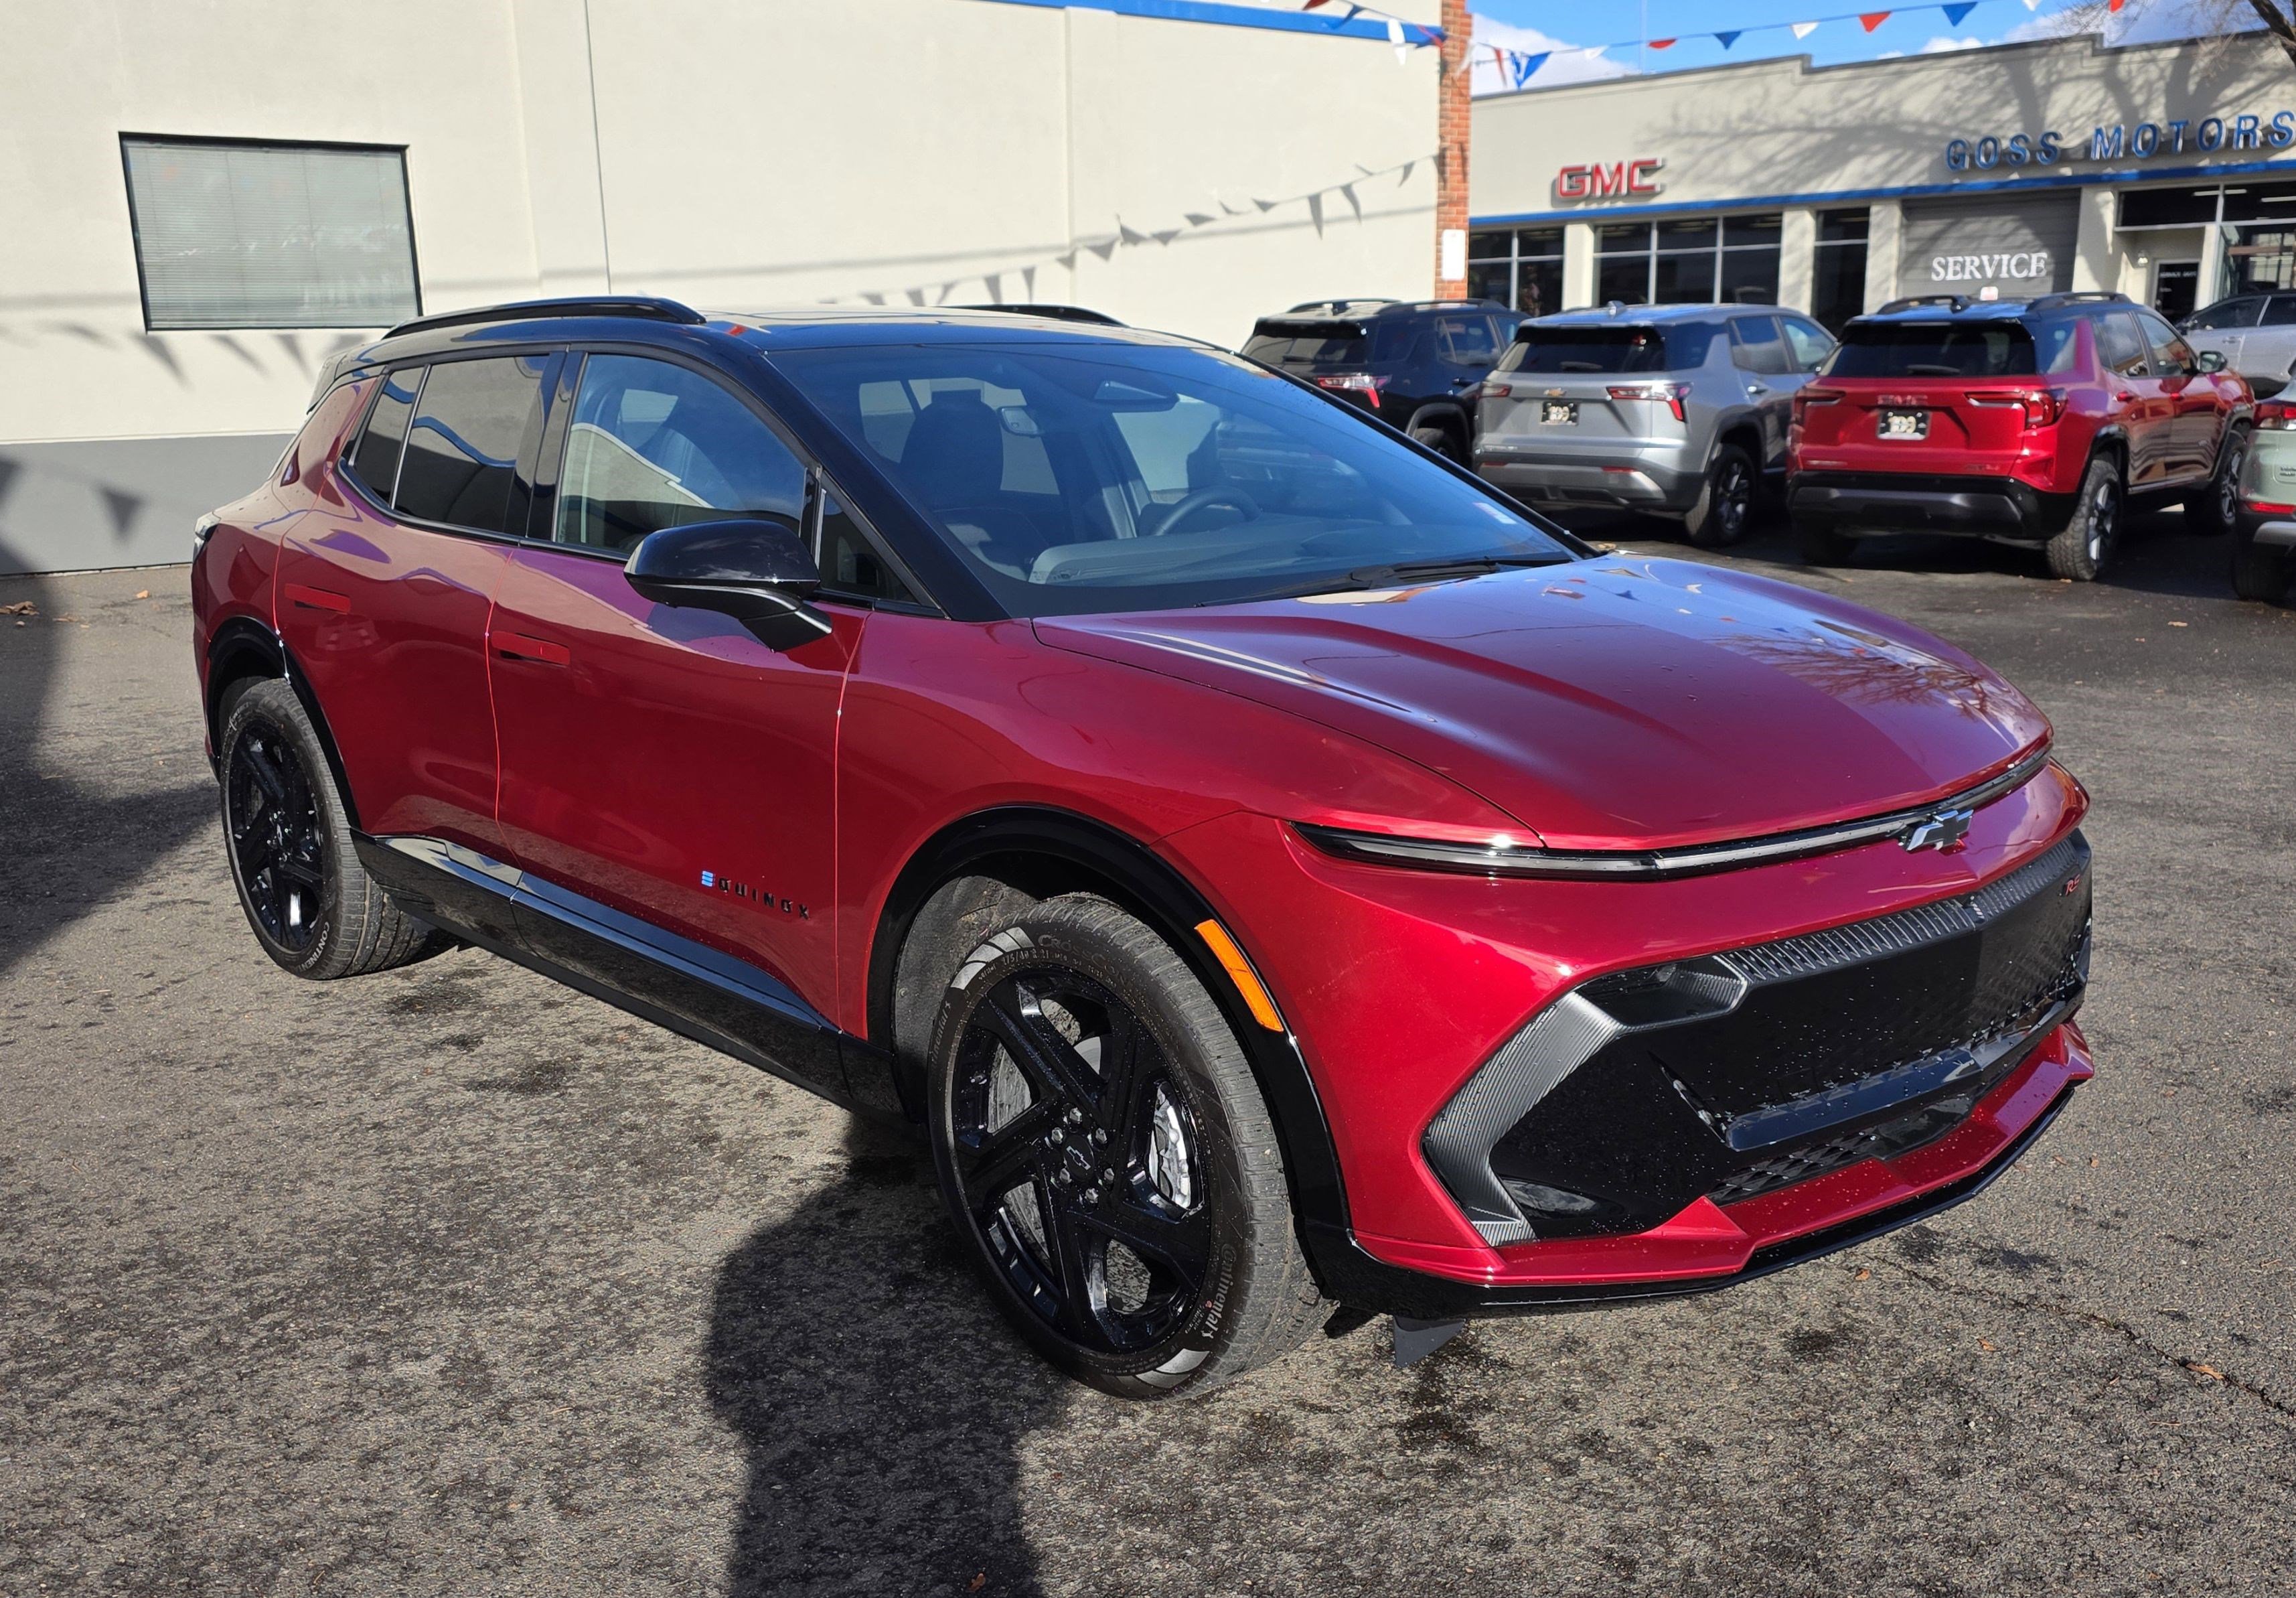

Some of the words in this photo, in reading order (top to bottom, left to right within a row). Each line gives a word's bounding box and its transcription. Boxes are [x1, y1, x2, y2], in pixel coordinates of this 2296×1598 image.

[1945, 131, 2062, 172] GOSS
[2090, 110, 2296, 161] MOTORS
[1557, 157, 1663, 199] GMC
[1931, 252, 2048, 281] SERVICE
[1877, 394, 1928, 405] GMC
[700, 869, 810, 920] EQUINOX
[2065, 873, 2080, 897] RS
